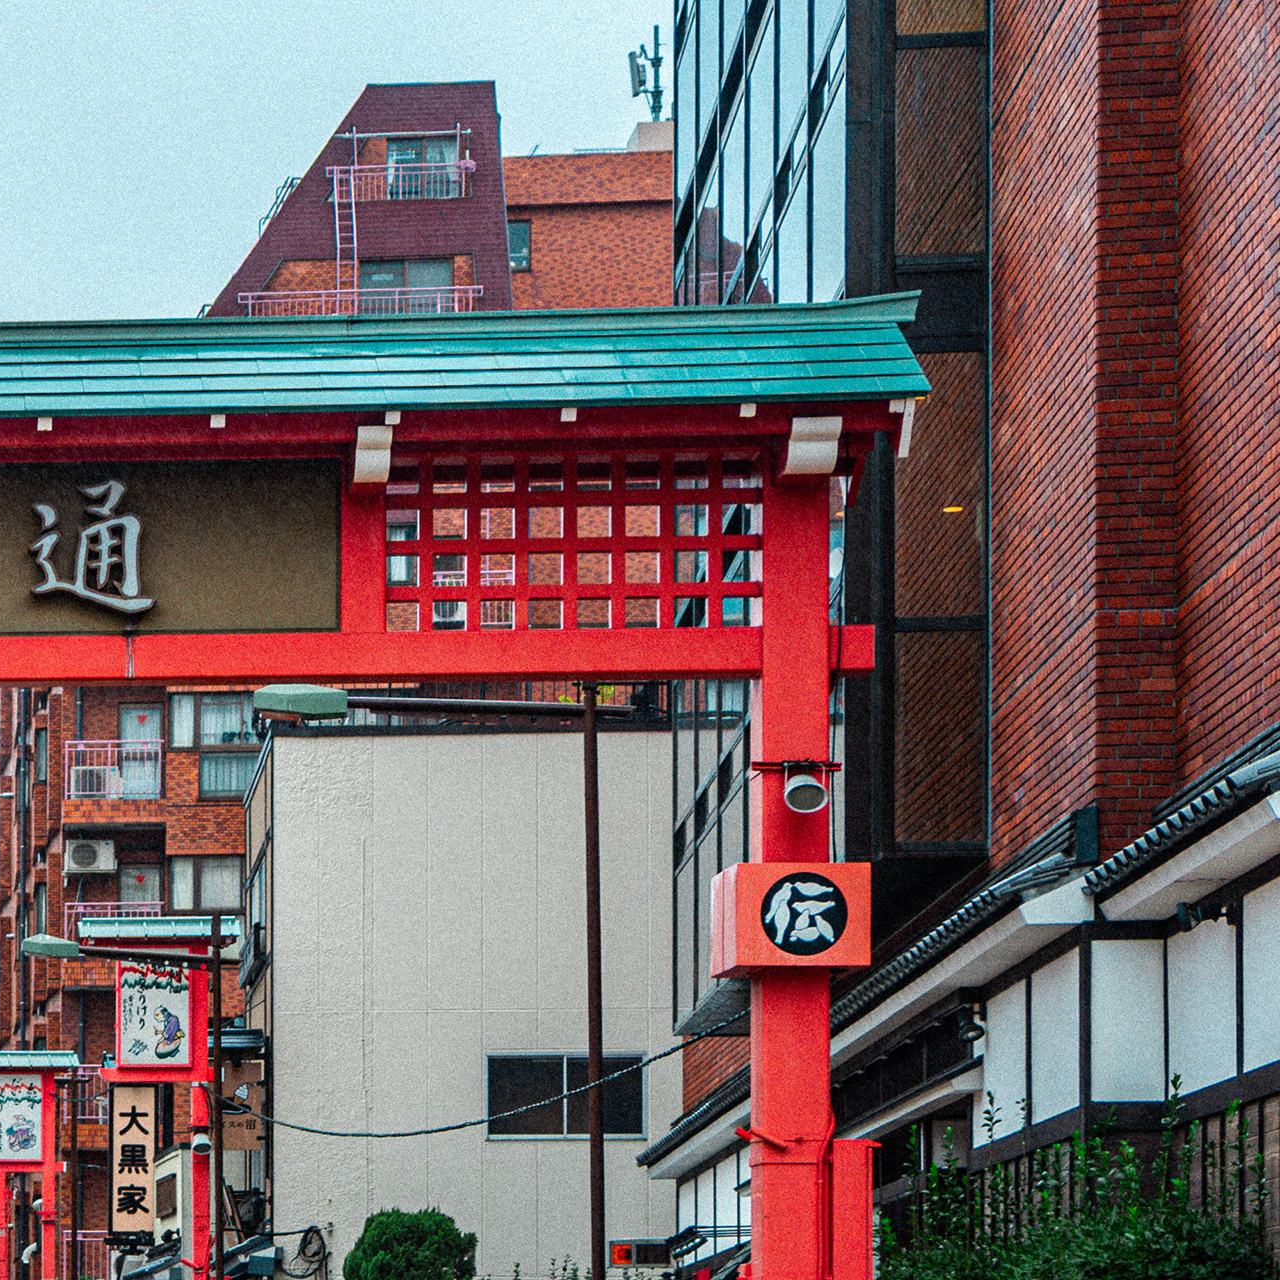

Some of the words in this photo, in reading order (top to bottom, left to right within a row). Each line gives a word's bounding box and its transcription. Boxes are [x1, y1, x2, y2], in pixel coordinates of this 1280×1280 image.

[765, 881, 837, 945] 伝
[116, 1105, 150, 1215] 大黒家
